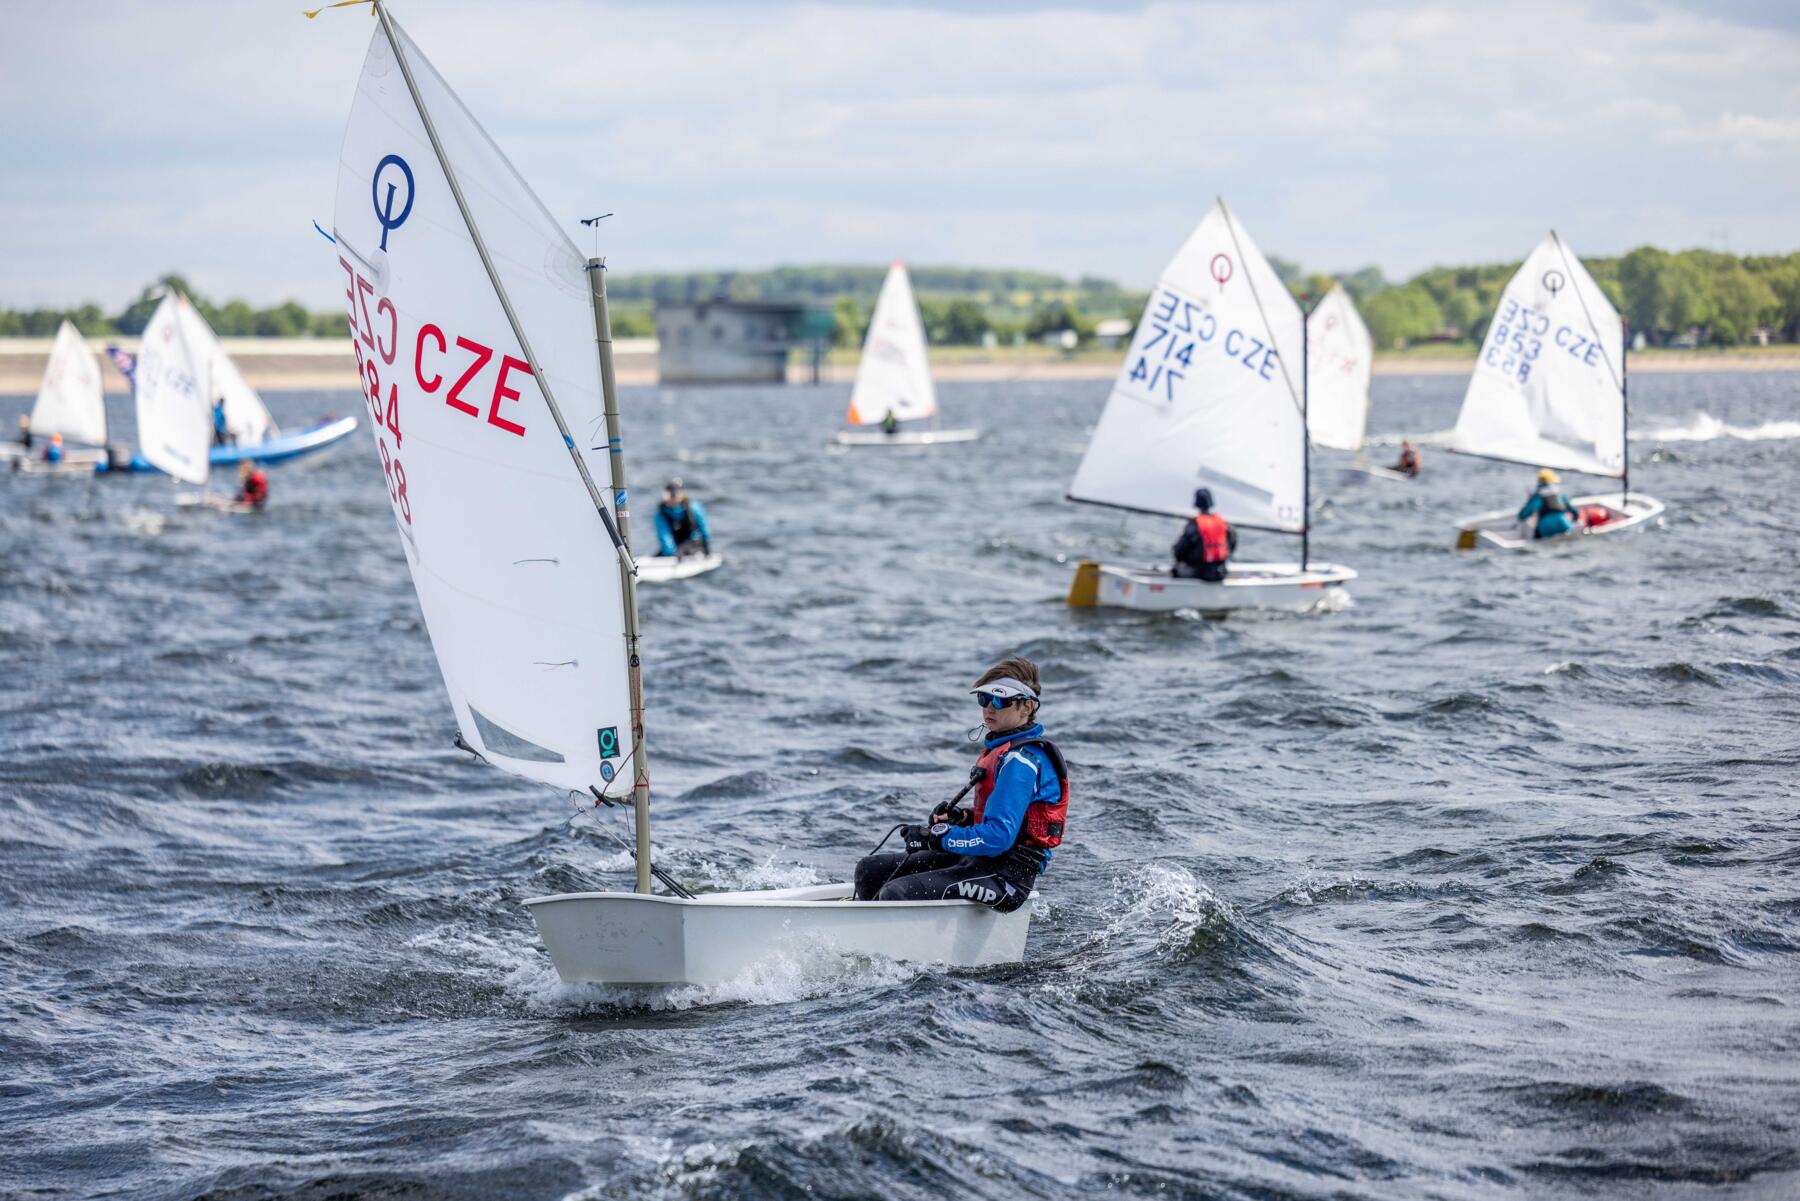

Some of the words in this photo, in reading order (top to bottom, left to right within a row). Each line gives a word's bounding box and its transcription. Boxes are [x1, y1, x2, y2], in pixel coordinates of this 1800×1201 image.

[1143, 323, 1195, 368] 714
[1225, 329, 1279, 381] CZE
[1555, 326, 1602, 368] CZE
[415, 323, 542, 438] CZE
[957, 881, 997, 903] WIP
